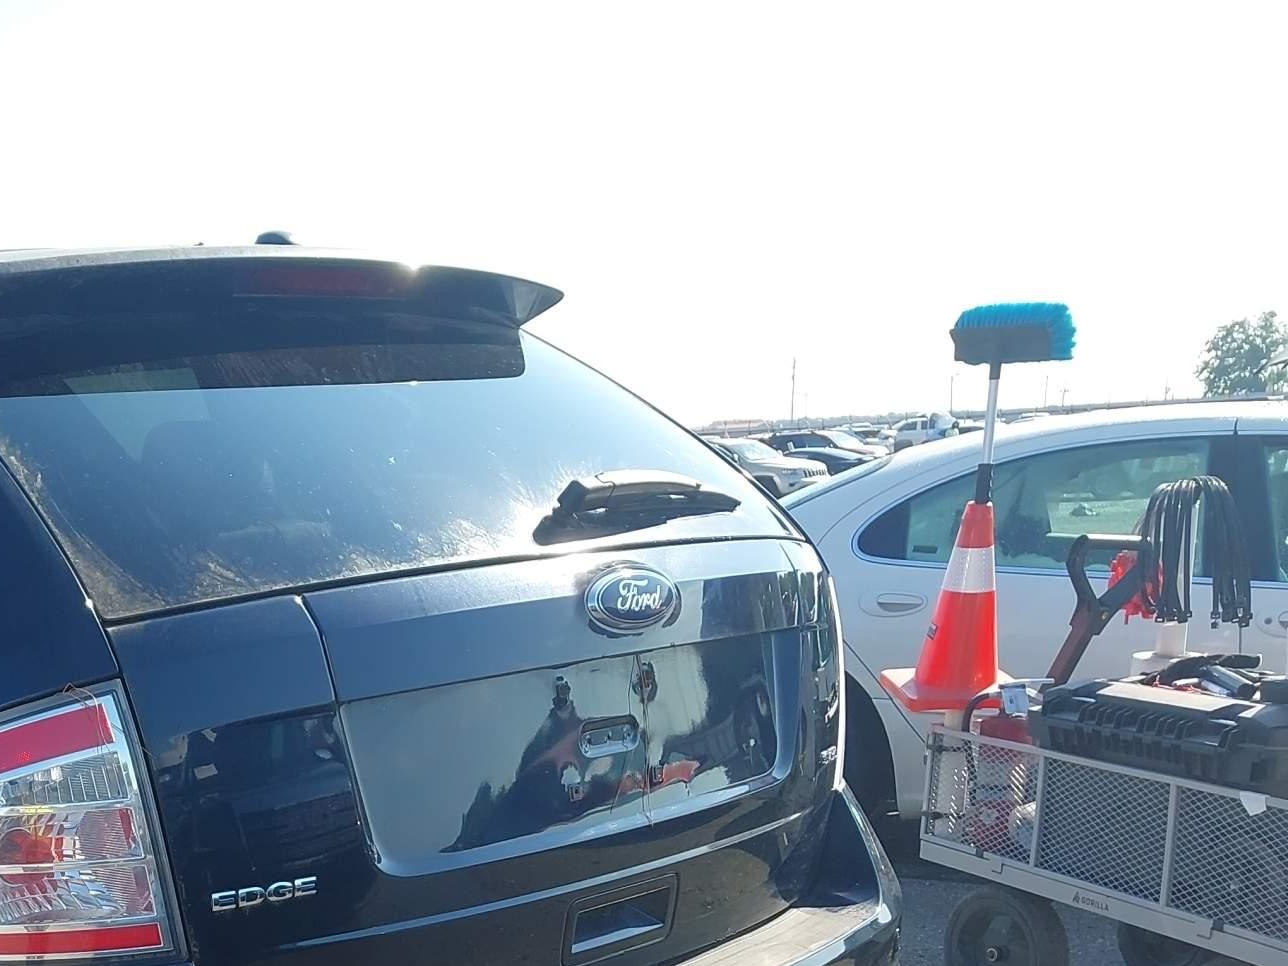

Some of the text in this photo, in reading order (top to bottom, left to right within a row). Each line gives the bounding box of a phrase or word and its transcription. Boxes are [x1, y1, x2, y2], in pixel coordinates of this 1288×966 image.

[617, 579, 664, 613] Ford
[211, 876, 318, 912] EDGE
[1081, 896, 1110, 912] GORILLA
